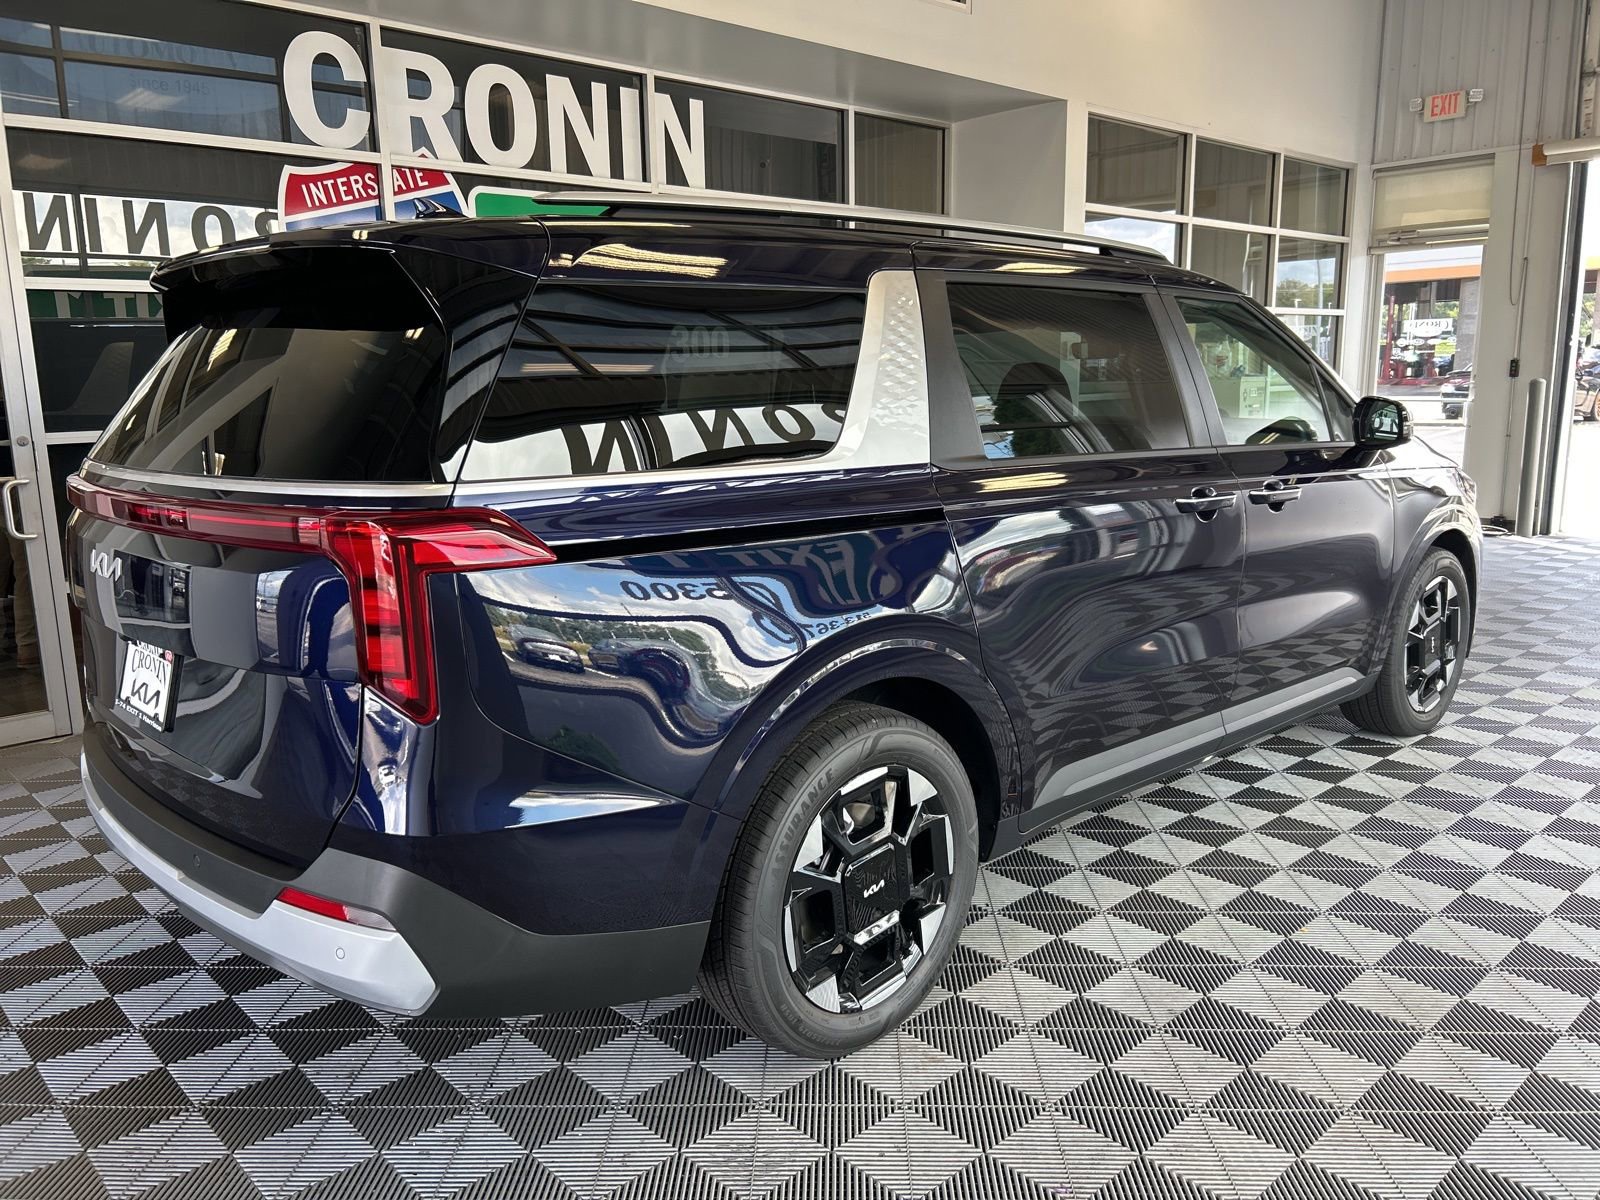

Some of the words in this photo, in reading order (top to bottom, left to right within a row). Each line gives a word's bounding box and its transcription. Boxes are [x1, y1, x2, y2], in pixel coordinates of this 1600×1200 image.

[175, 79, 210, 97] 1945
[1430, 92, 1460, 118] EXIT
[283, 31, 706, 189] CRONIN
[301, 168, 429, 208] INTERSATE
[132, 648, 169, 689] CRONIN
[768, 767, 835, 879] ASSURANCE
